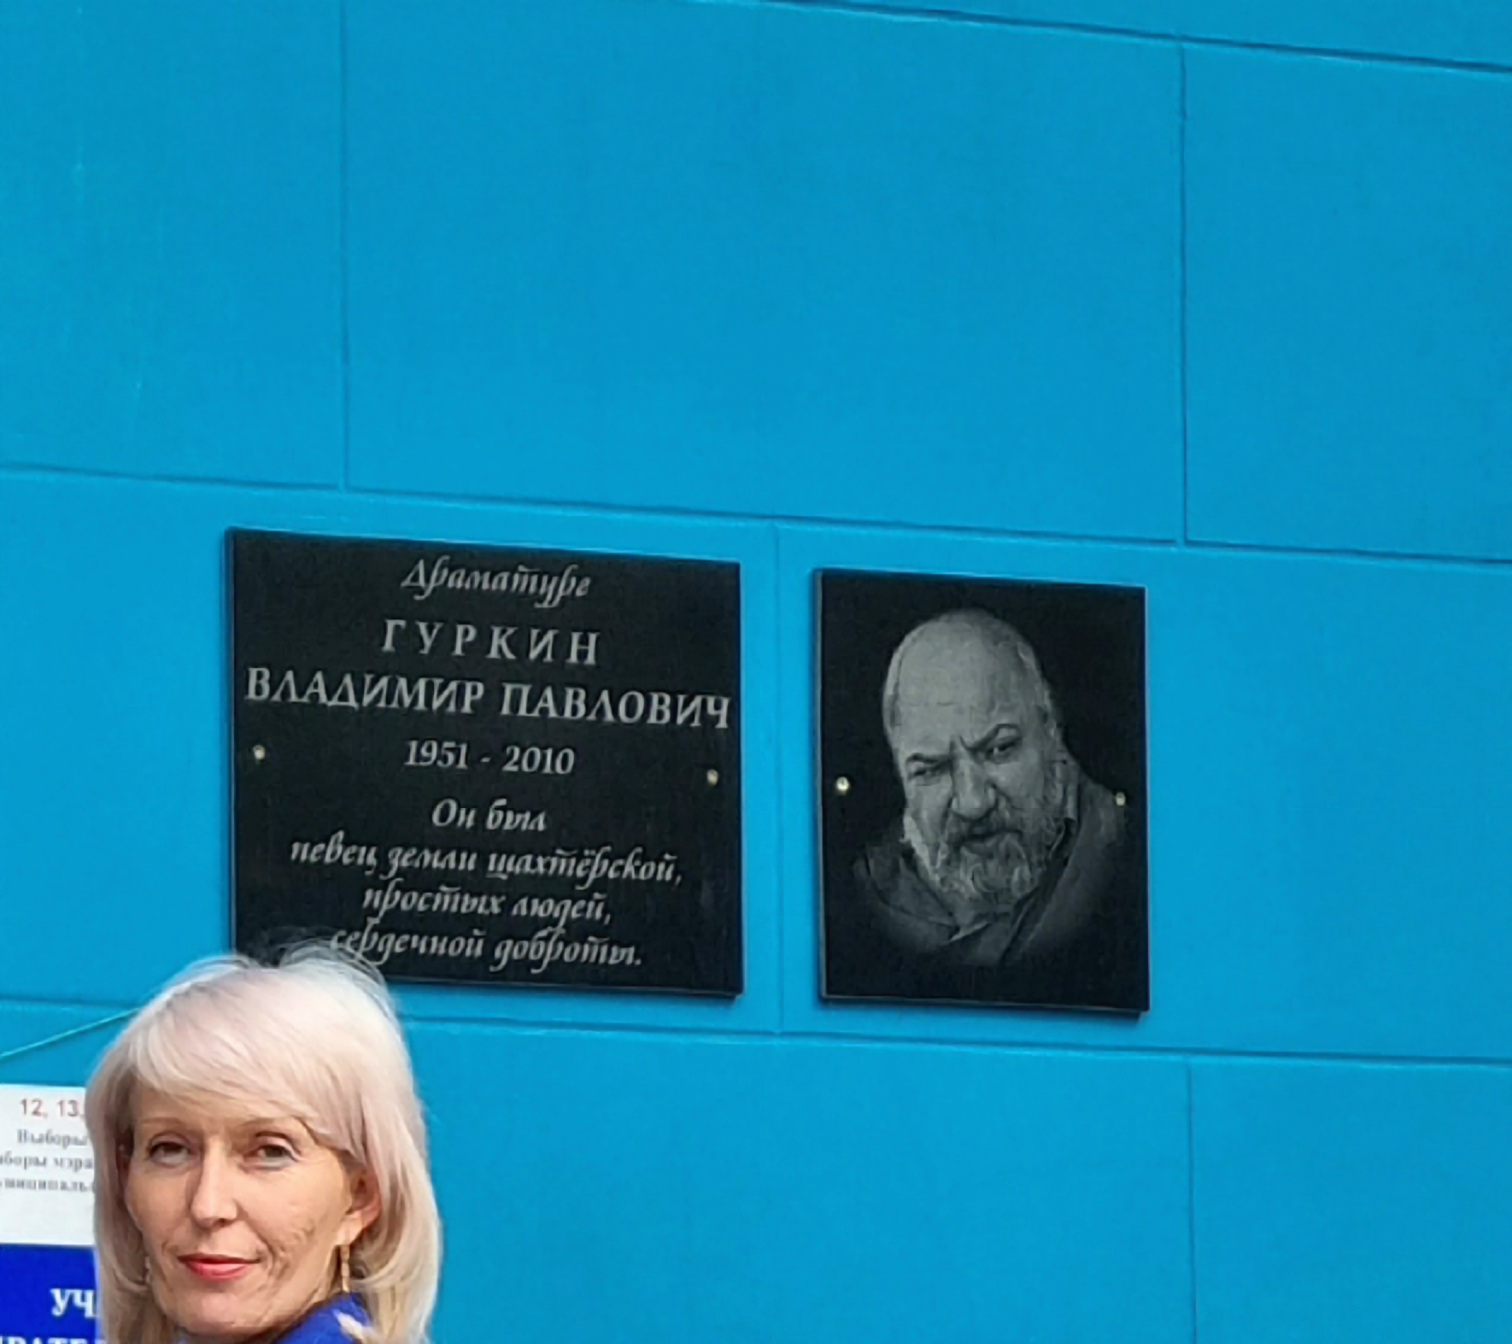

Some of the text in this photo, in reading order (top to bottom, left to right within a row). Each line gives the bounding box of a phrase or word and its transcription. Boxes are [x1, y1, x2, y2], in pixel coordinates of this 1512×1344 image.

[400, 555, 592, 609] Драматург
[381, 618, 600, 666] ГУРКИН
[245, 666, 731, 729] ВЛАДИМИР ПАВЛОВИЧ
[404, 739, 469, 770] 1951
[501, 745, 575, 775] 2010
[431, 798, 546, 831] Он был
[290, 830, 682, 890] певец земли шахтёрской,
[362, 877, 612, 934] простых людей,
[330, 926, 642, 974] сердечной доброты.
